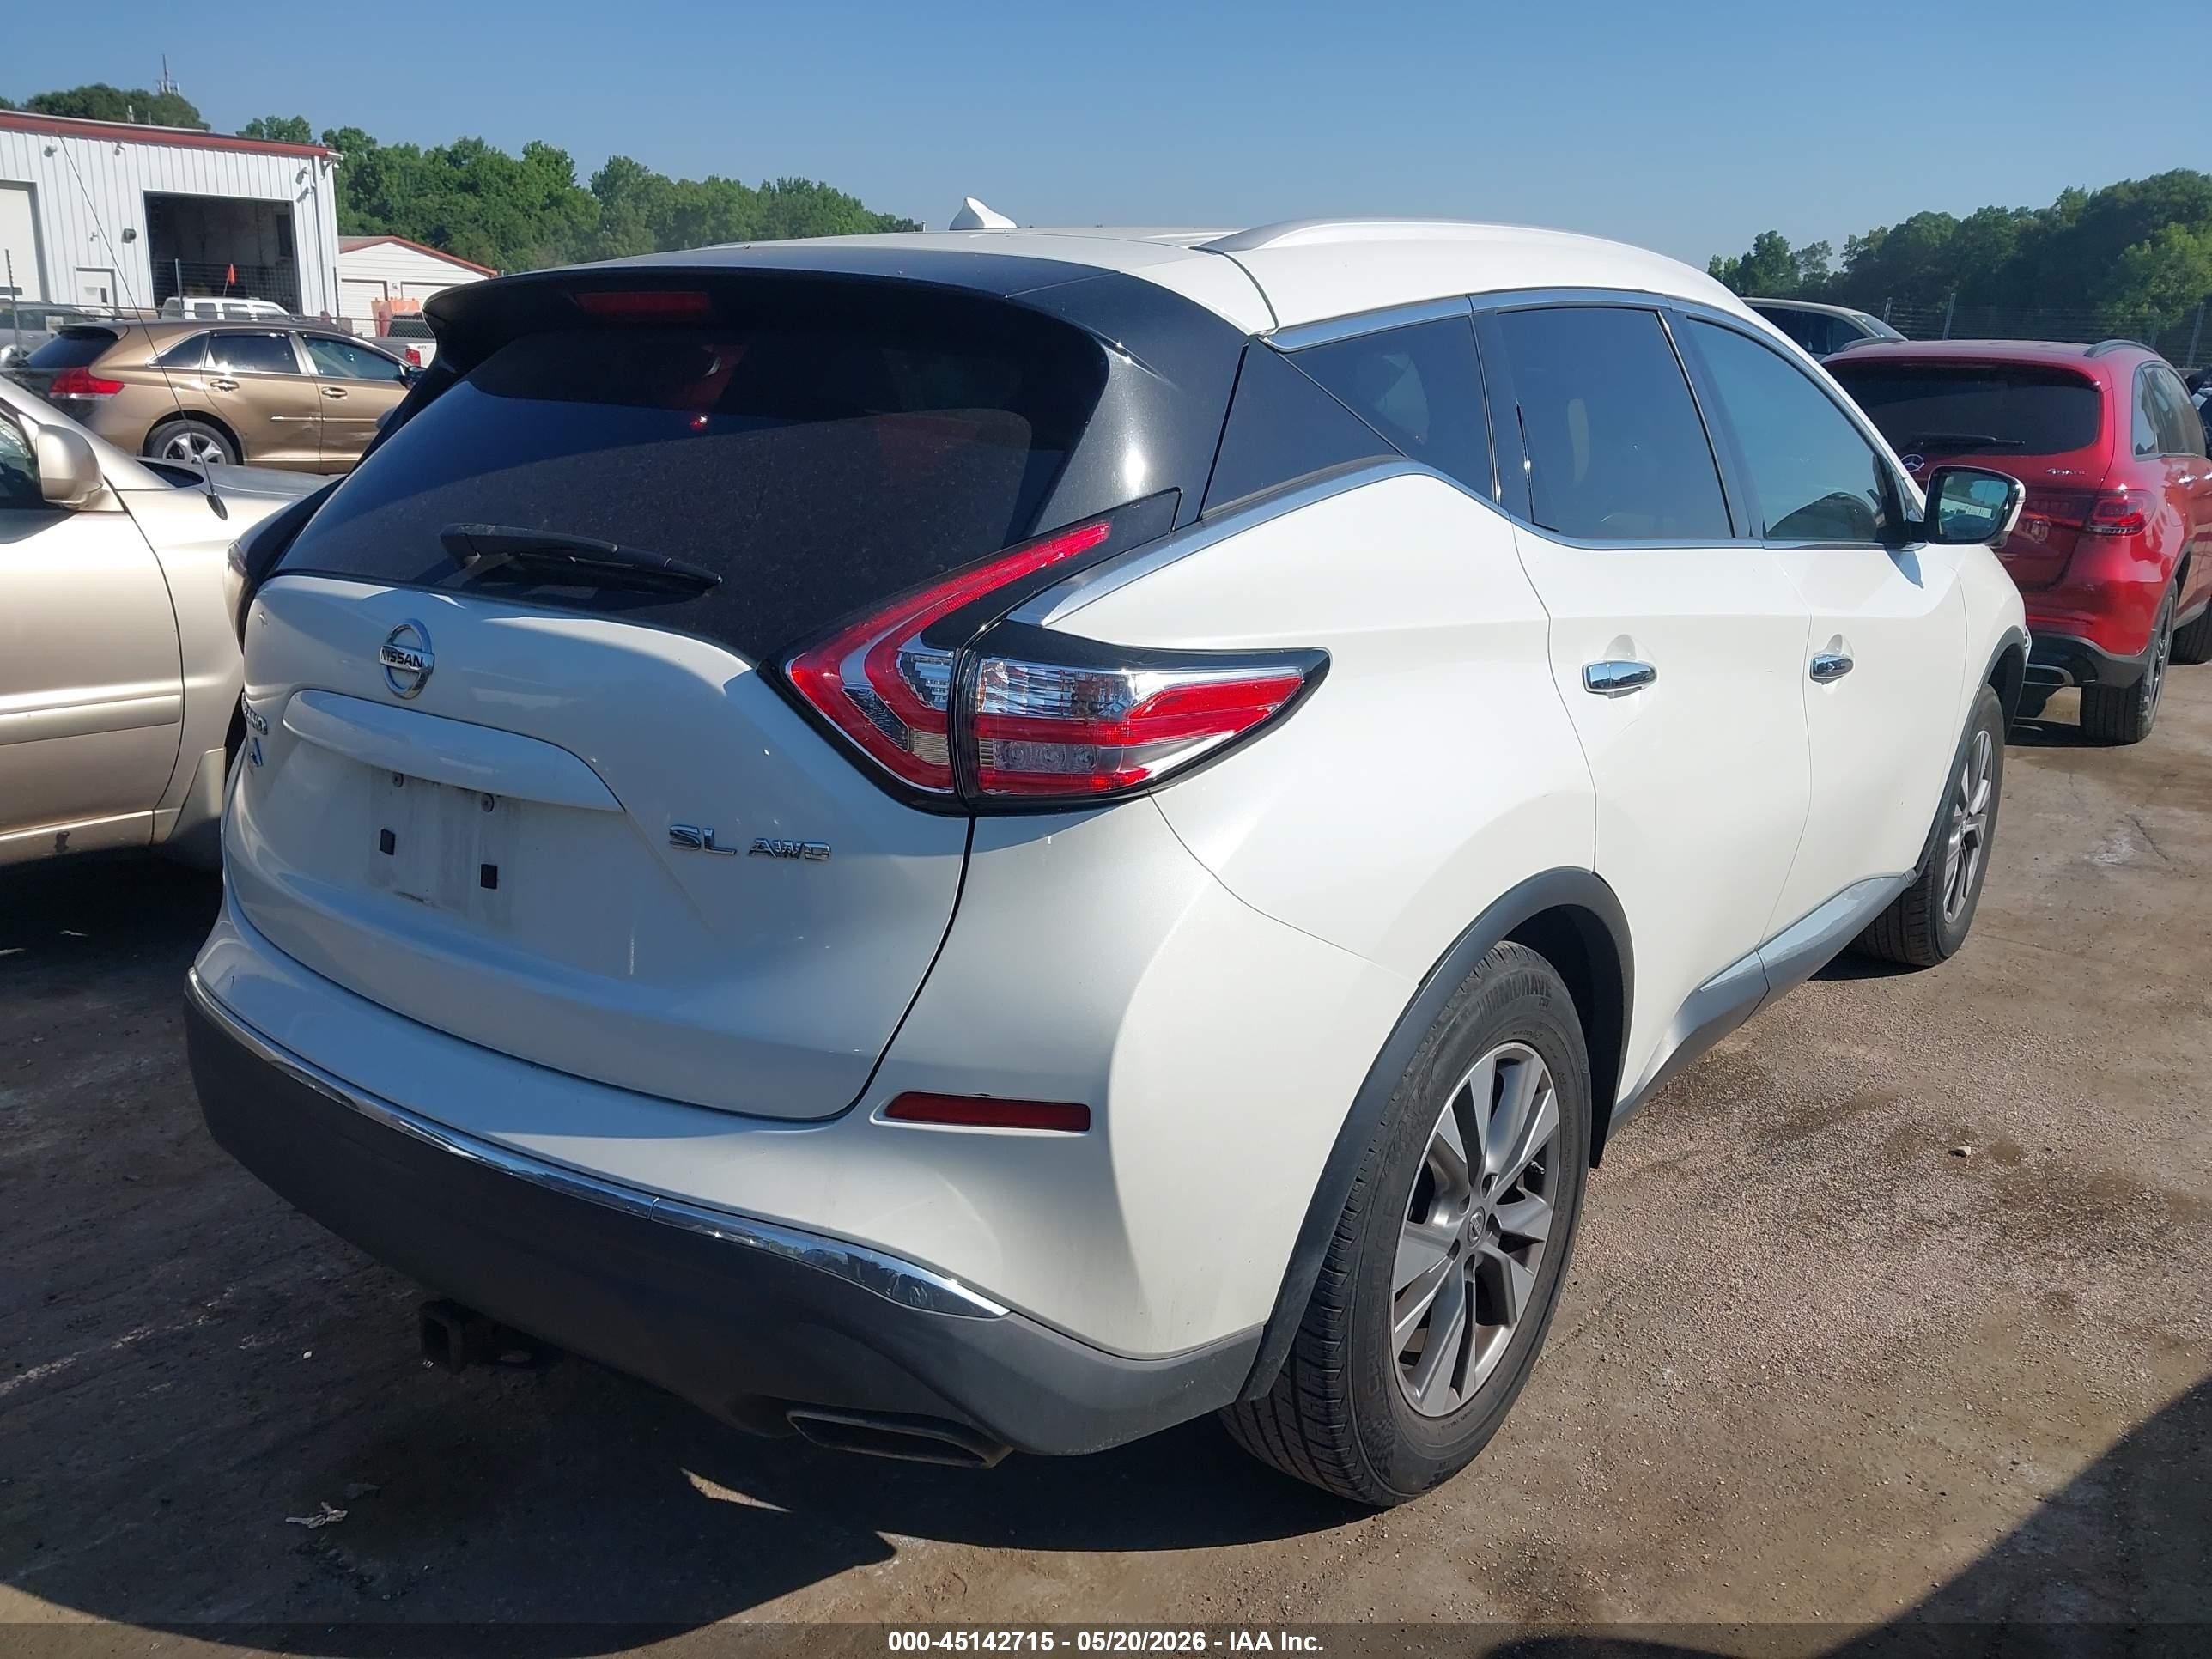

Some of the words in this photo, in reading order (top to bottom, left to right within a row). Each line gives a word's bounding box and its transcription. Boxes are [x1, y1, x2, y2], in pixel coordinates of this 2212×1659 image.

[380, 647, 423, 668] NISSAN
[669, 824, 737, 855] SL
[748, 836, 832, 860] AWD
